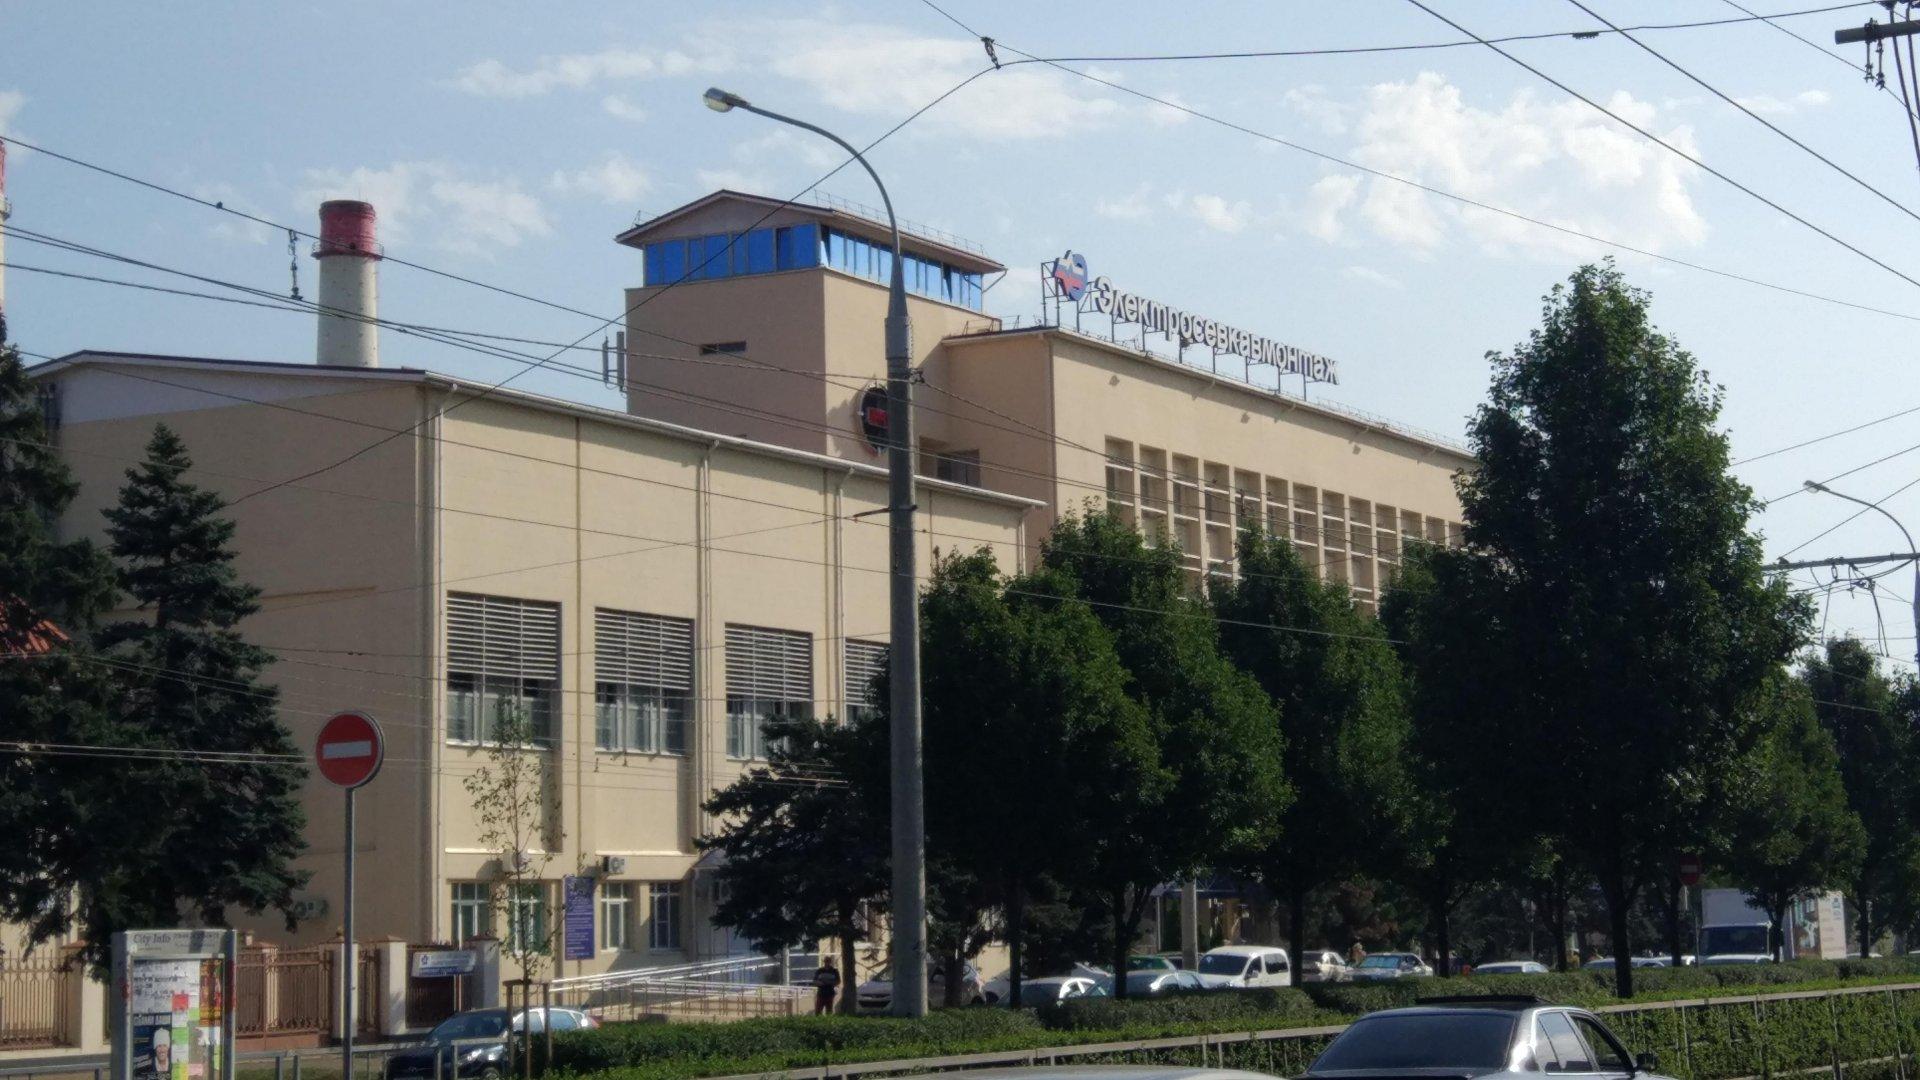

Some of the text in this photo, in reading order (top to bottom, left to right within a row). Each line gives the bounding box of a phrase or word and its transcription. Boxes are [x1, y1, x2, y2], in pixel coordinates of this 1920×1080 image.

[1093, 276, 1340, 385] Электросевкавмонтаж
[133, 933, 150, 945] City
[153, 933, 171, 944] Info
